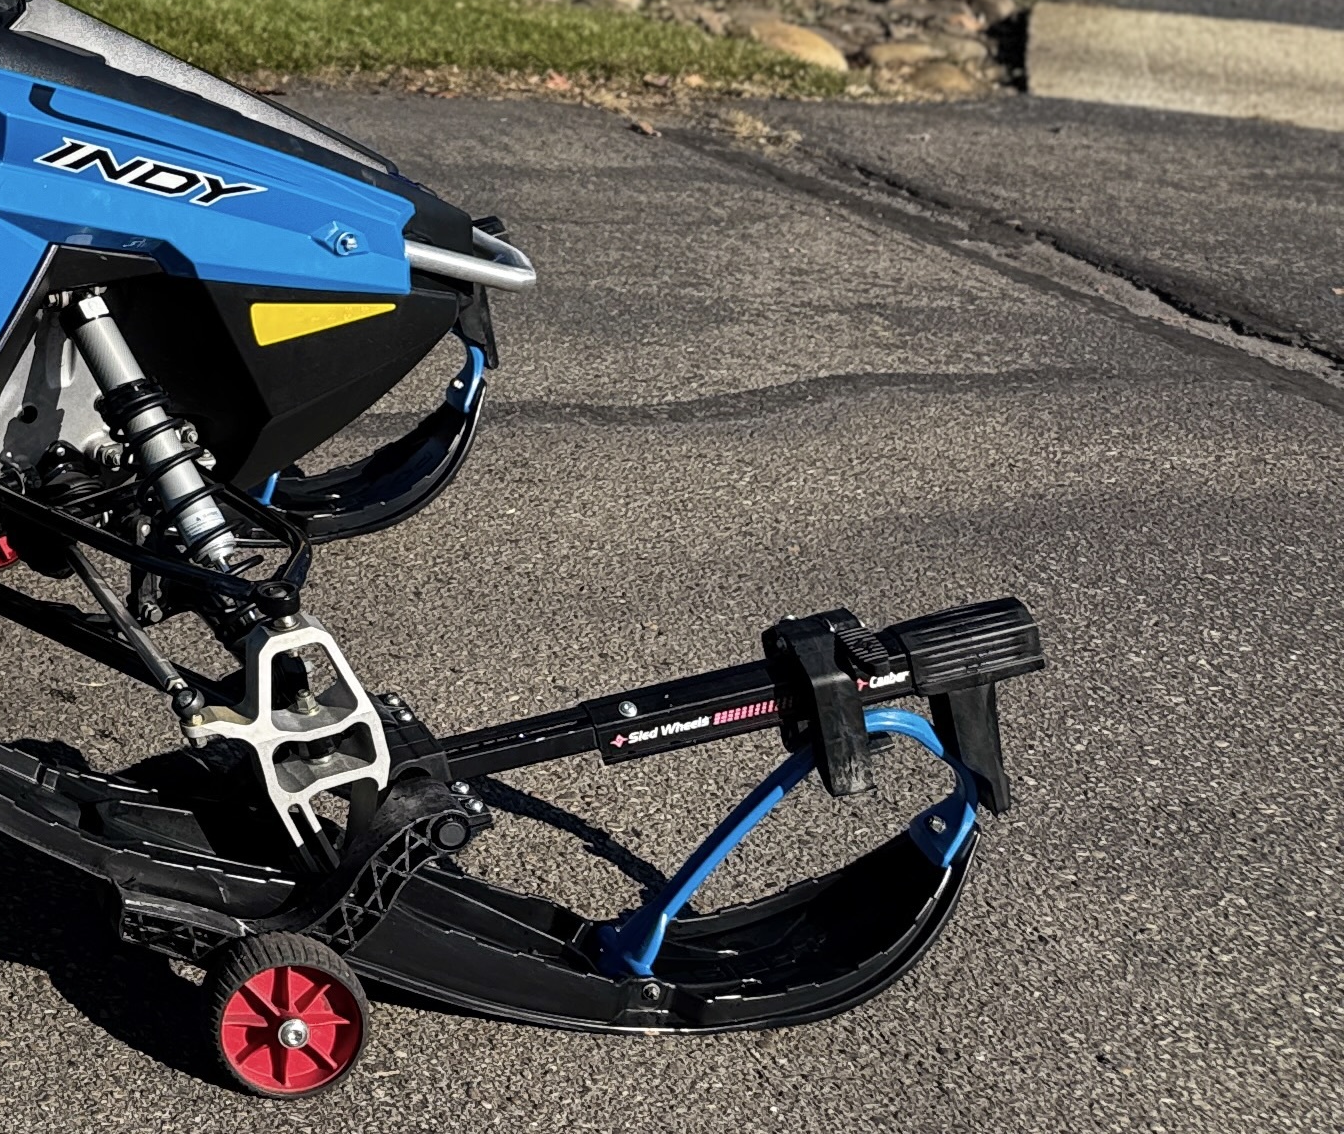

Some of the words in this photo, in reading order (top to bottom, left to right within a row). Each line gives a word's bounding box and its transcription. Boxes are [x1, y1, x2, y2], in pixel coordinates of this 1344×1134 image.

[34, 137, 269, 207] INDY
[627, 727, 659, 745] Sled
[660, 716, 711, 736] Wheels
